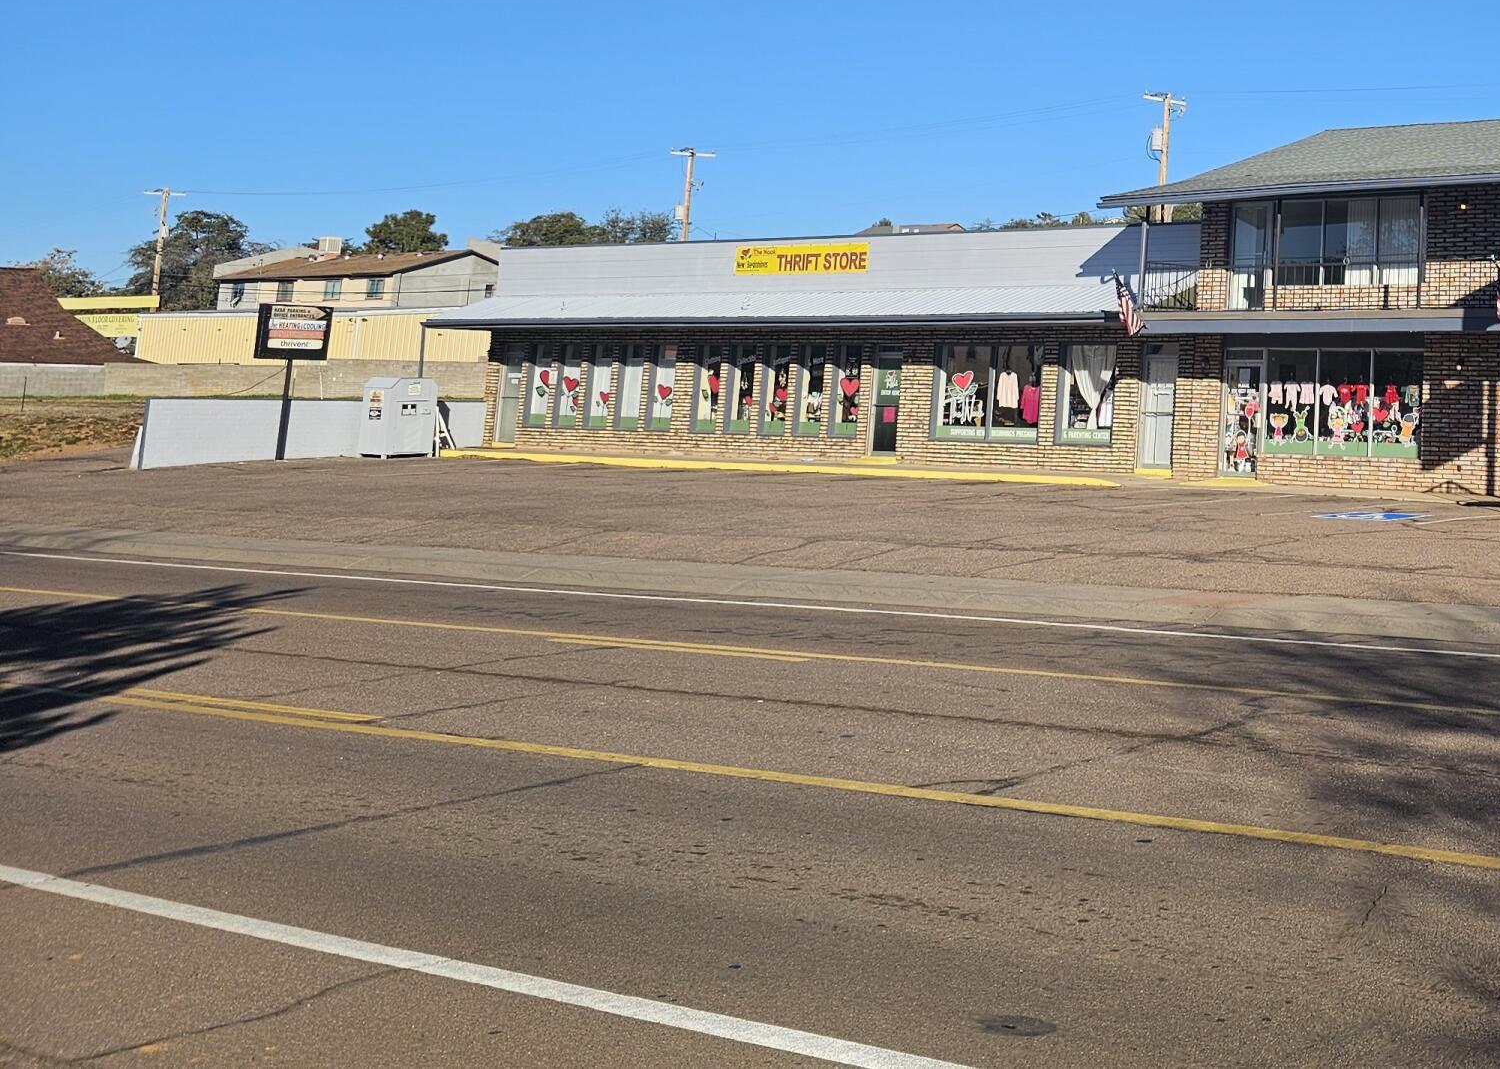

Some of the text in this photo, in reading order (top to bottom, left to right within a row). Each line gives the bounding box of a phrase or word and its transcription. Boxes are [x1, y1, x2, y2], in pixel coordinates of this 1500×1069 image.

[777, 251, 867, 271] THRIFT STORE
[280, 340, 309, 348] thrivent
